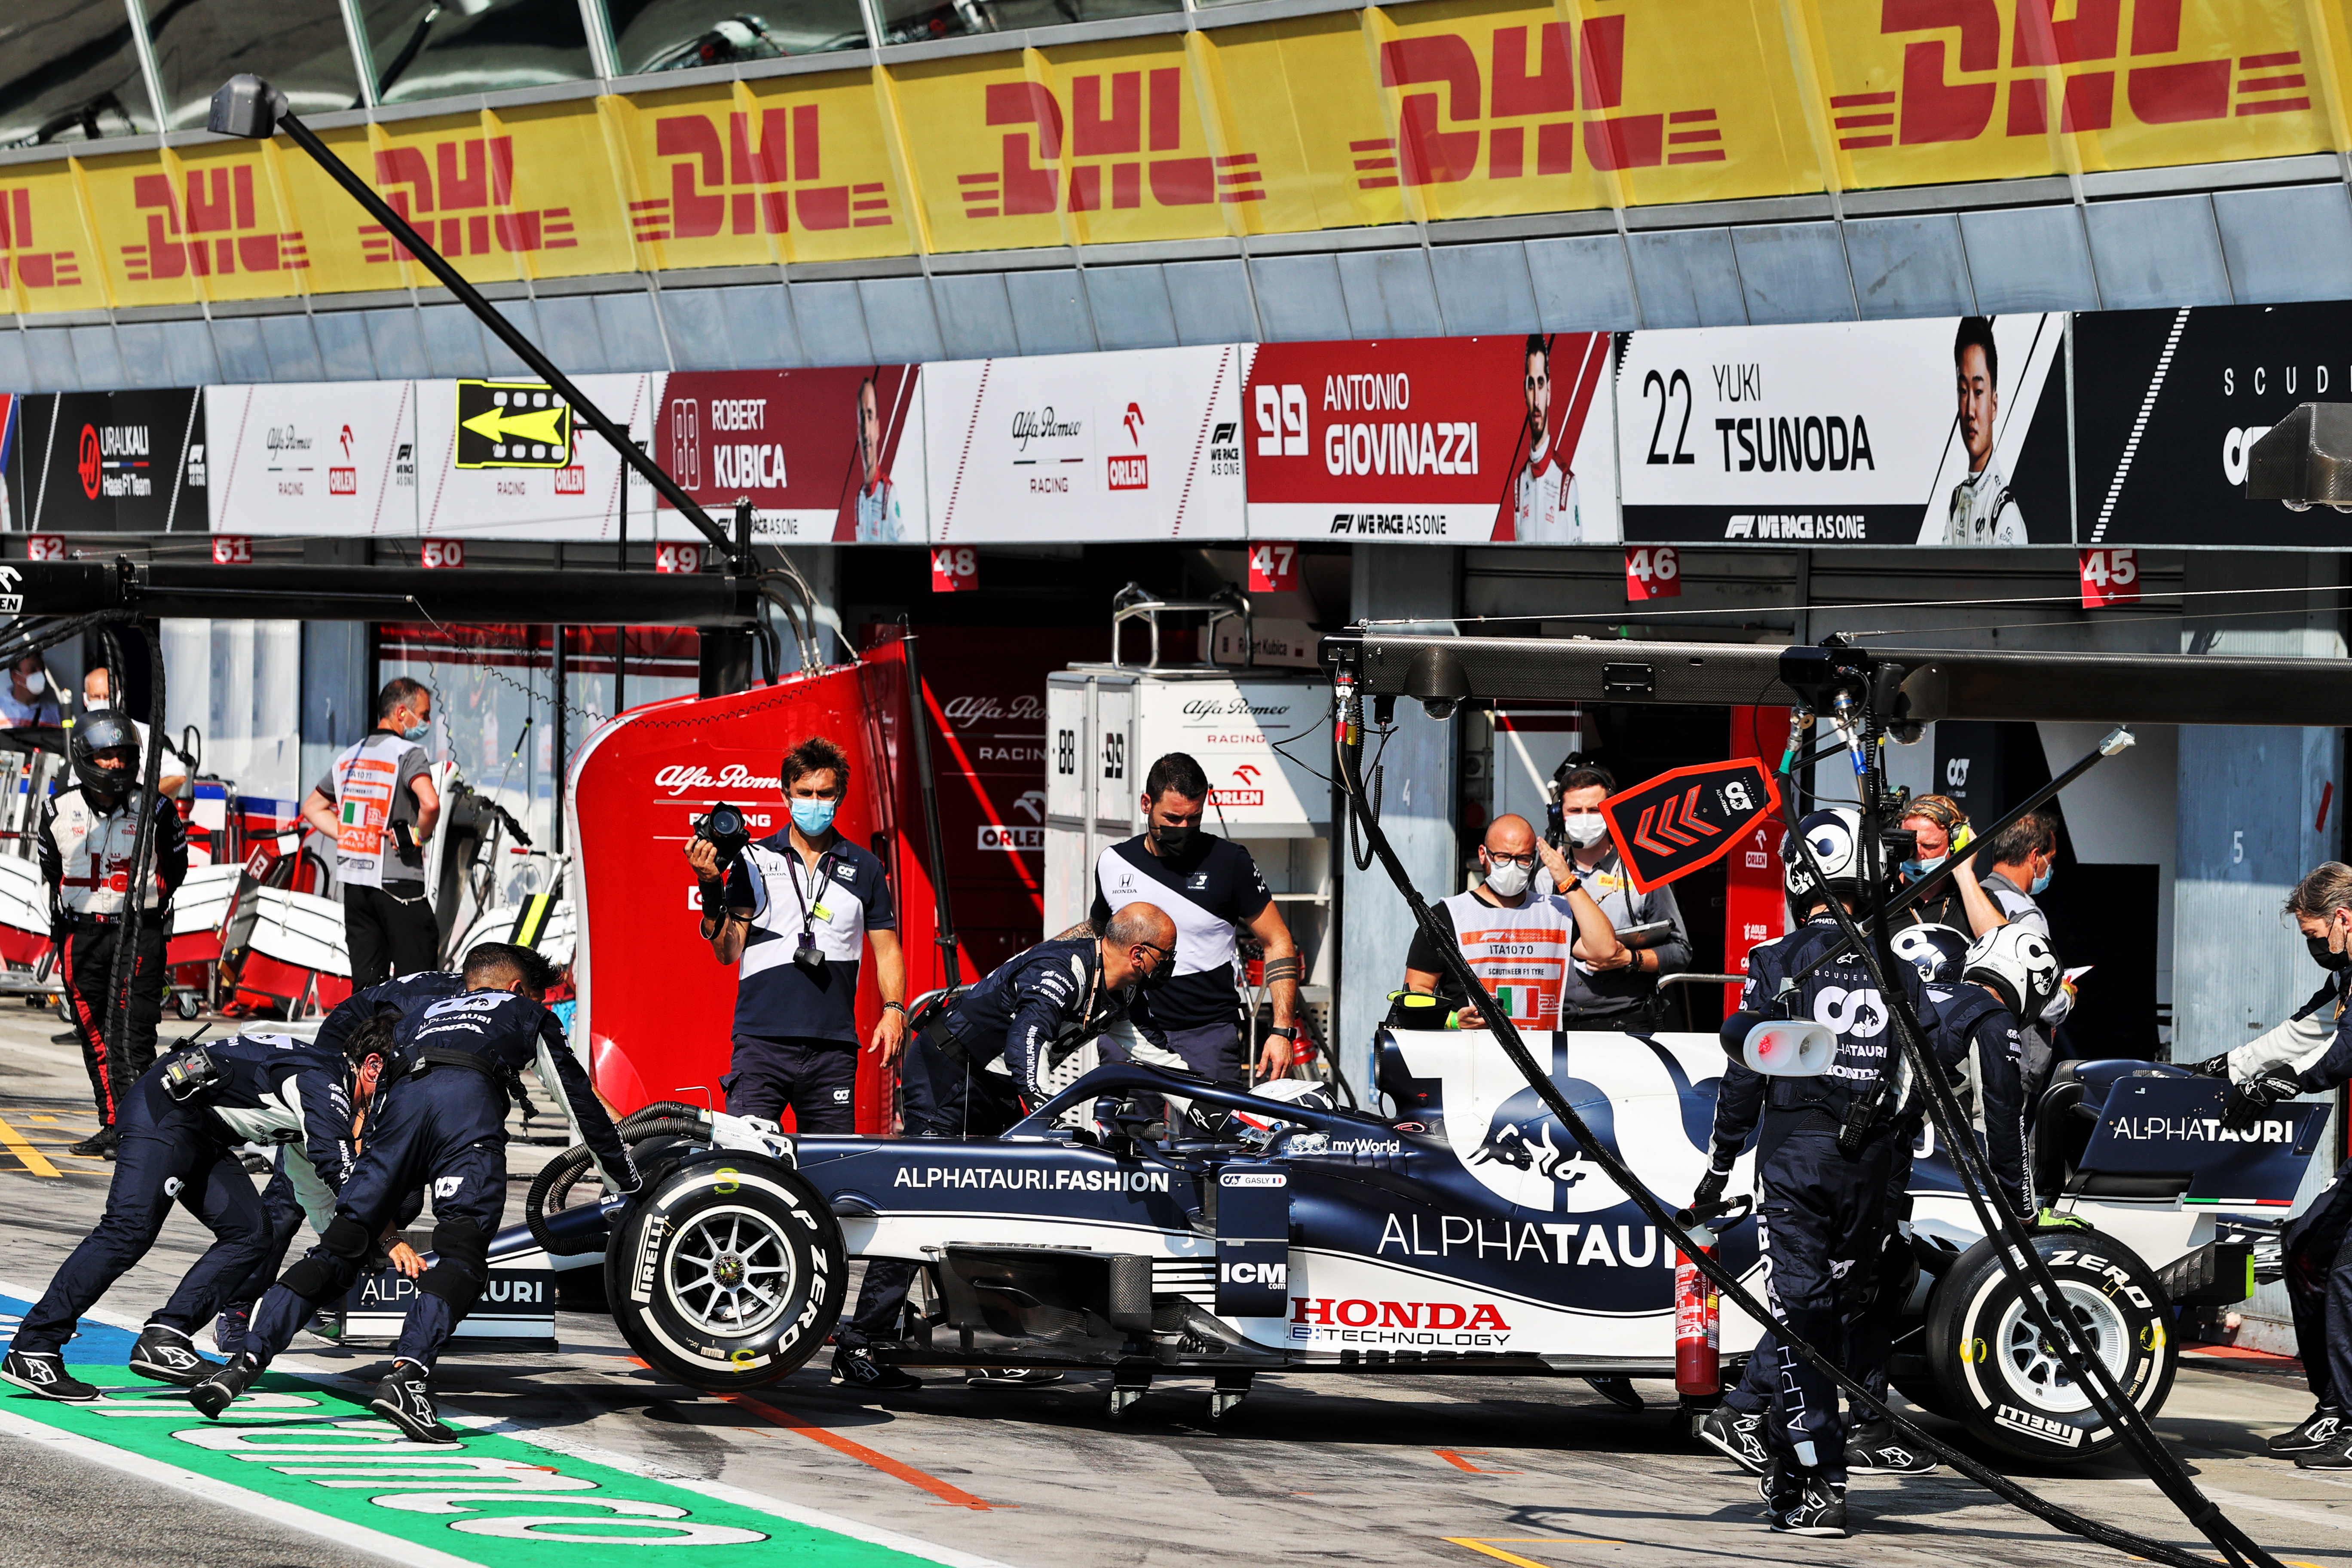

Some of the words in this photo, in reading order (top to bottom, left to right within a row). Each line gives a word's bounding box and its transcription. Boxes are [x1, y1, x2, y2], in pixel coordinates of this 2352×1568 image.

[1880, 0, 2232, 145] DHL
[1381, 14, 1662, 186] DHL
[986, 67, 1214, 215] DHL
[656, 104, 849, 238] DHL
[375, 135, 541, 262] DHL
[134, 165, 279, 279] DHL
[1323, 373, 1409, 411] ANTONIO
[1712, 364, 1761, 402] YUKI
[2224, 365, 2352, 396] SCUD
[712, 399, 767, 431] ROBERT
[1013, 411, 1039, 452] Alfa
[1041, 406, 1082, 438] Romeo
[1255, 384, 1309, 456] 99
[1643, 369, 1695, 465] 22
[100, 426, 149, 456] URALKALI
[1325, 422, 1479, 476] GIOVINAZZI
[1715, 414, 1875, 473] TSUNODA
[331, 469, 355, 493] ORLEN
[556, 469, 583, 493] ORLEN
[714, 444, 787, 488] KUBICA
[1109, 459, 1147, 487] ORLEN
[103, 474, 122, 496] Haas
[122, 473, 131, 495] F1
[130, 474, 151, 496] Team
[278, 482, 304, 496] RACING
[497, 481, 525, 496] RACING
[1031, 478, 1069, 493] RACING
[1357, 514, 1375, 534] WE
[1377, 514, 1403, 534] RACE
[1406, 514, 1421, 535] AS
[1423, 514, 1446, 535] ONE
[1757, 515, 1779, 539] WE
[1780, 515, 1814, 539] RACE
[1816, 515, 1835, 539] AS
[1835, 515, 1866, 539] ONE
[31, 538, 64, 559] 52
[215, 539, 251, 562] 51
[425, 542, 462, 567] 50
[658, 547, 698, 572] 49
[934, 548, 976, 576] 48
[1251, 546, 1294, 576] 47
[1628, 547, 1677, 582] 46
[2083, 549, 2136, 587] 45
[945, 695, 1006, 729] Alfa
[1183, 699, 1225, 722] Alfa
[1226, 698, 1290, 715] Romeo
[979, 747, 1046, 761] RACIN
[1059, 729, 1074, 775] 88
[1207, 734, 1266, 744] RACING
[655, 765, 717, 796] Alfa
[716, 764, 781, 789] Rom
[1402, 778, 1411, 806] 4
[1209, 790, 1262, 805] ORLEN
[1747, 854, 1766, 867] ORLEN
[2233, 830, 2243, 864] 5
[1995, 952, 2014, 963] randstad
[1814, 969, 1868, 981] SCUDER
[1040, 988, 1066, 1008] randstad
[2113, 1117, 2293, 1143] ALPHATAURI
[1333, 1138, 1400, 1153] myWorld
[894, 1167, 1169, 1193] ALPHATAURI.FASHION
[1377, 1213, 1675, 1268] ALPHATAU
[631, 1213, 666, 1304] PIRELLI
[1221, 1262, 1286, 1284] ICM
[361, 1278, 542, 1303] ALPURI
[2048, 1250, 2153, 1309] ZERO
[778, 1244, 829, 1354] ZERO
[1290, 1297, 1511, 1331] HONDA
[1994, 1403, 2084, 1449] PIRELLI
